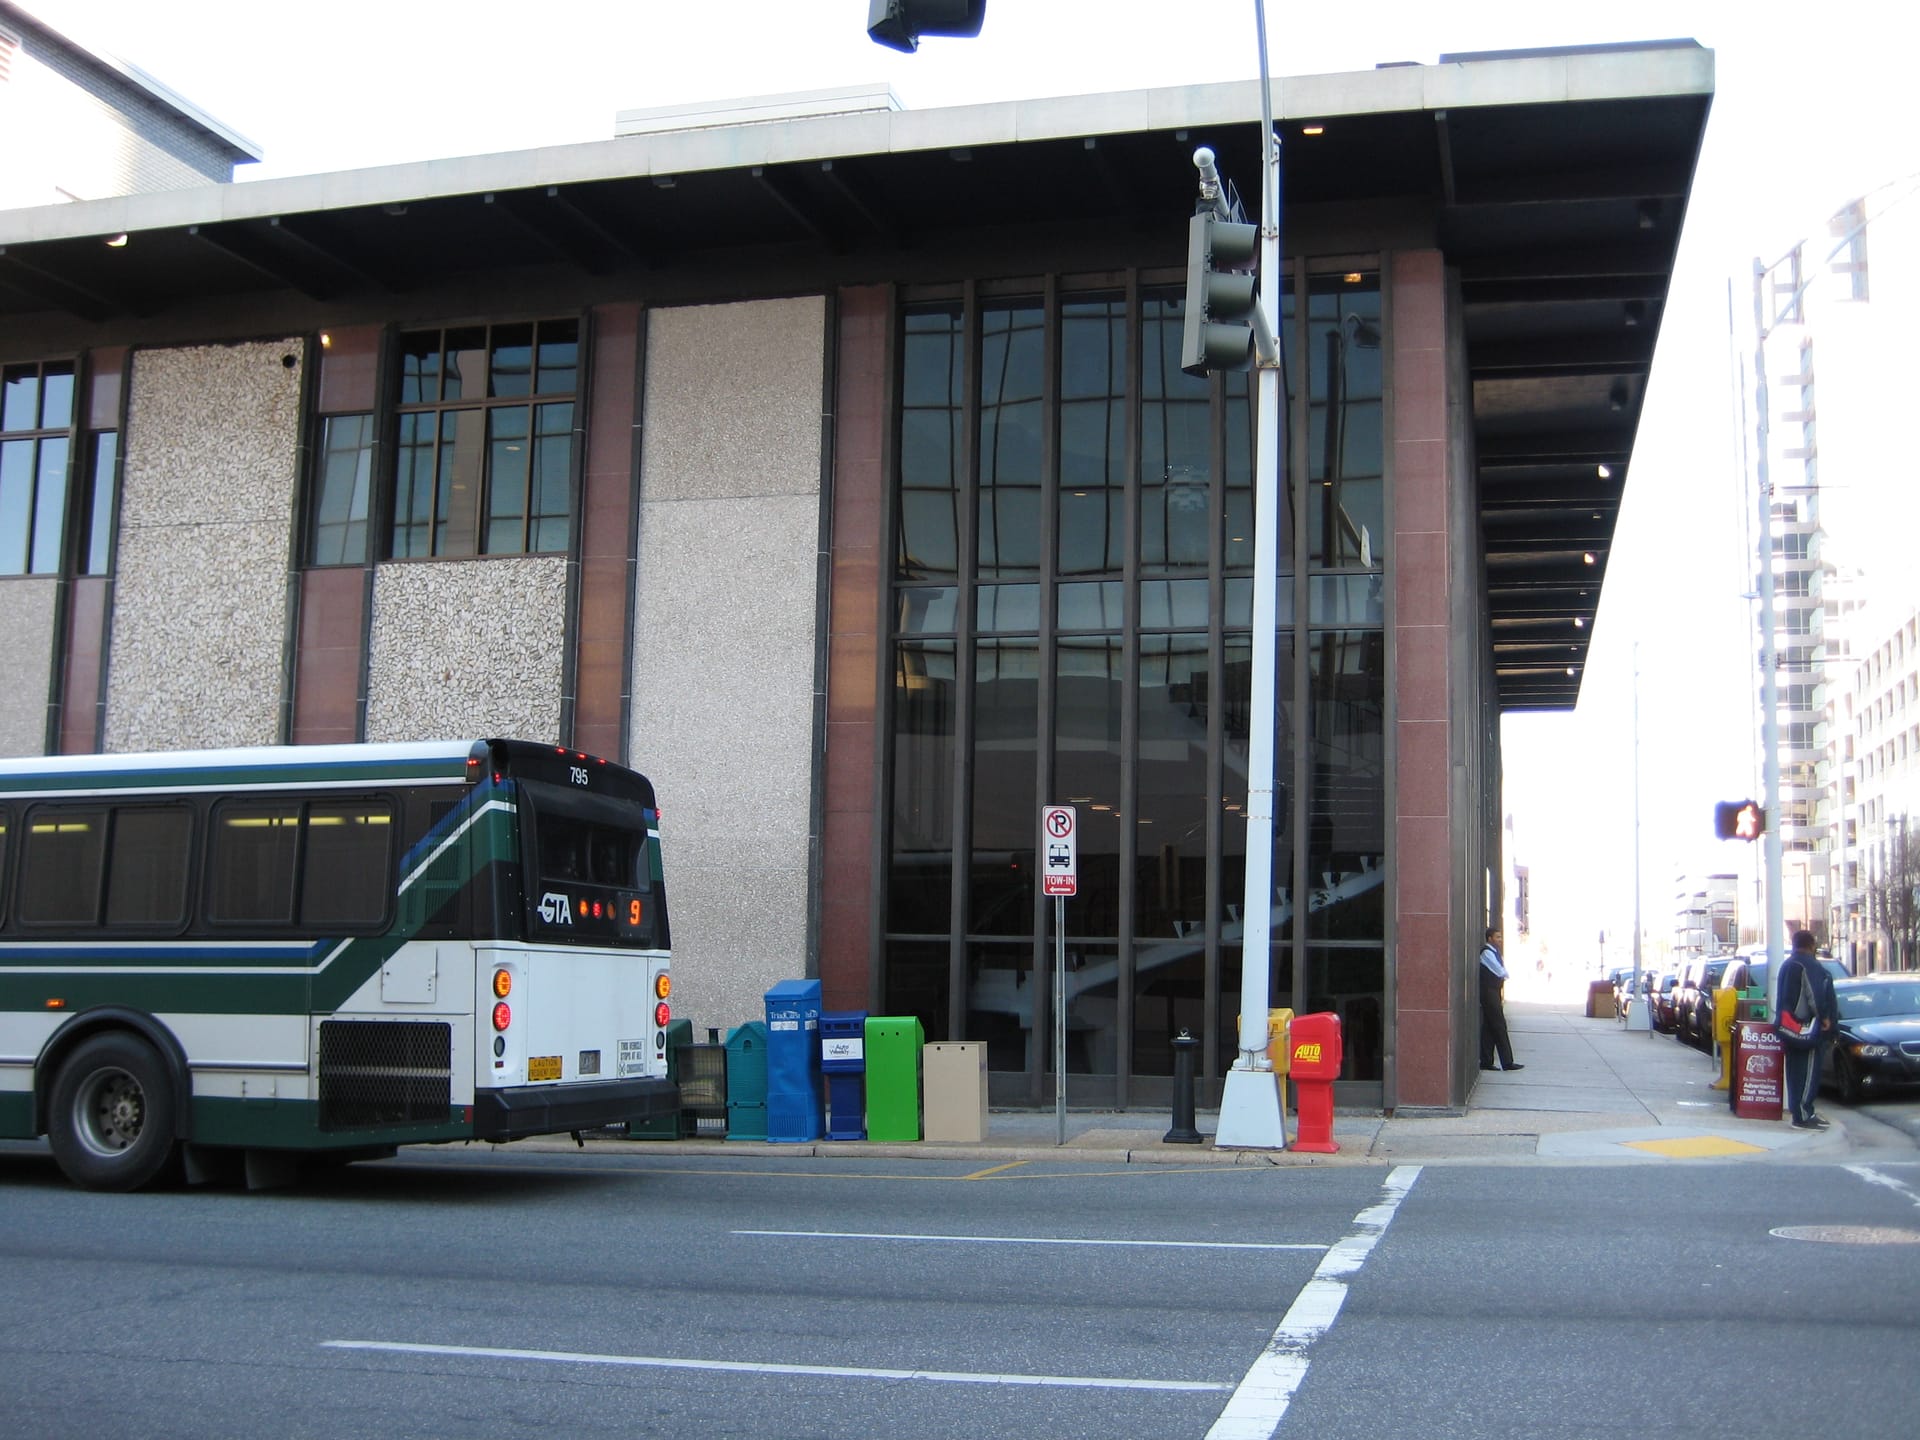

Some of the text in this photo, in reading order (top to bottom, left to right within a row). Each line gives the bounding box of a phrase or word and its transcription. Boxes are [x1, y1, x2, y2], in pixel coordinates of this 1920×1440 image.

[570, 766, 589, 785] 795
[1046, 876, 1074, 885] TOW-IN
[537, 892, 573, 924] GTA
[630, 899, 641, 925] 9
[1294, 1043, 1321, 1058] AUTO
[533, 1059, 558, 1068] CAUTION
[1743, 1082, 1776, 1090] Advertising
